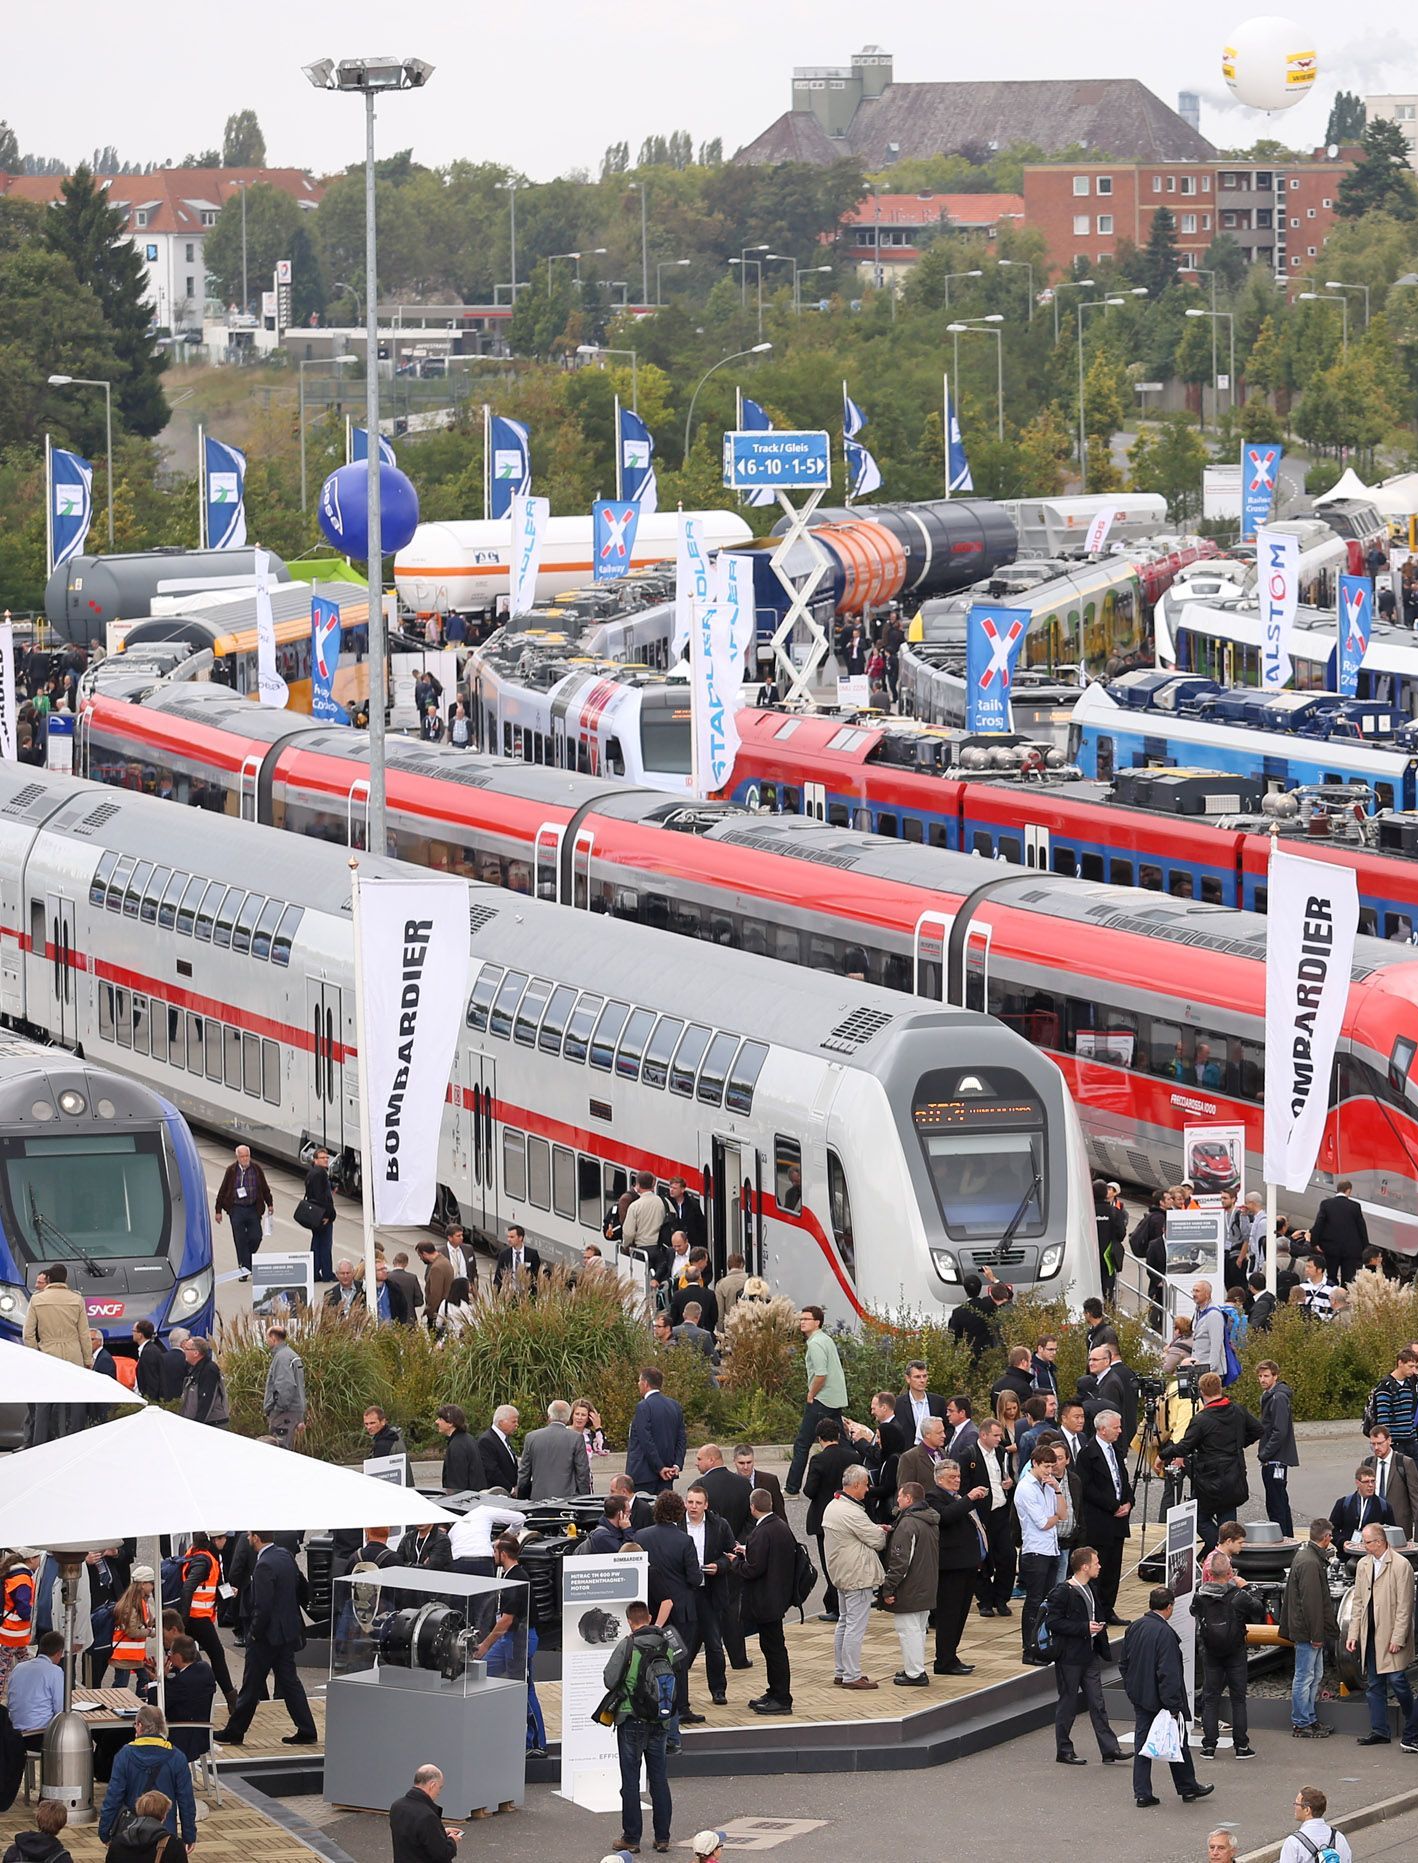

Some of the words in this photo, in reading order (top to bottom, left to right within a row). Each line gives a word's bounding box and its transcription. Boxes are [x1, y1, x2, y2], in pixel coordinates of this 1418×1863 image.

[386, 919, 433, 1182] BOMBARDIER
[1291, 895, 1333, 1120] OMBARDIER
[87, 1303, 123, 1316] SNCF
